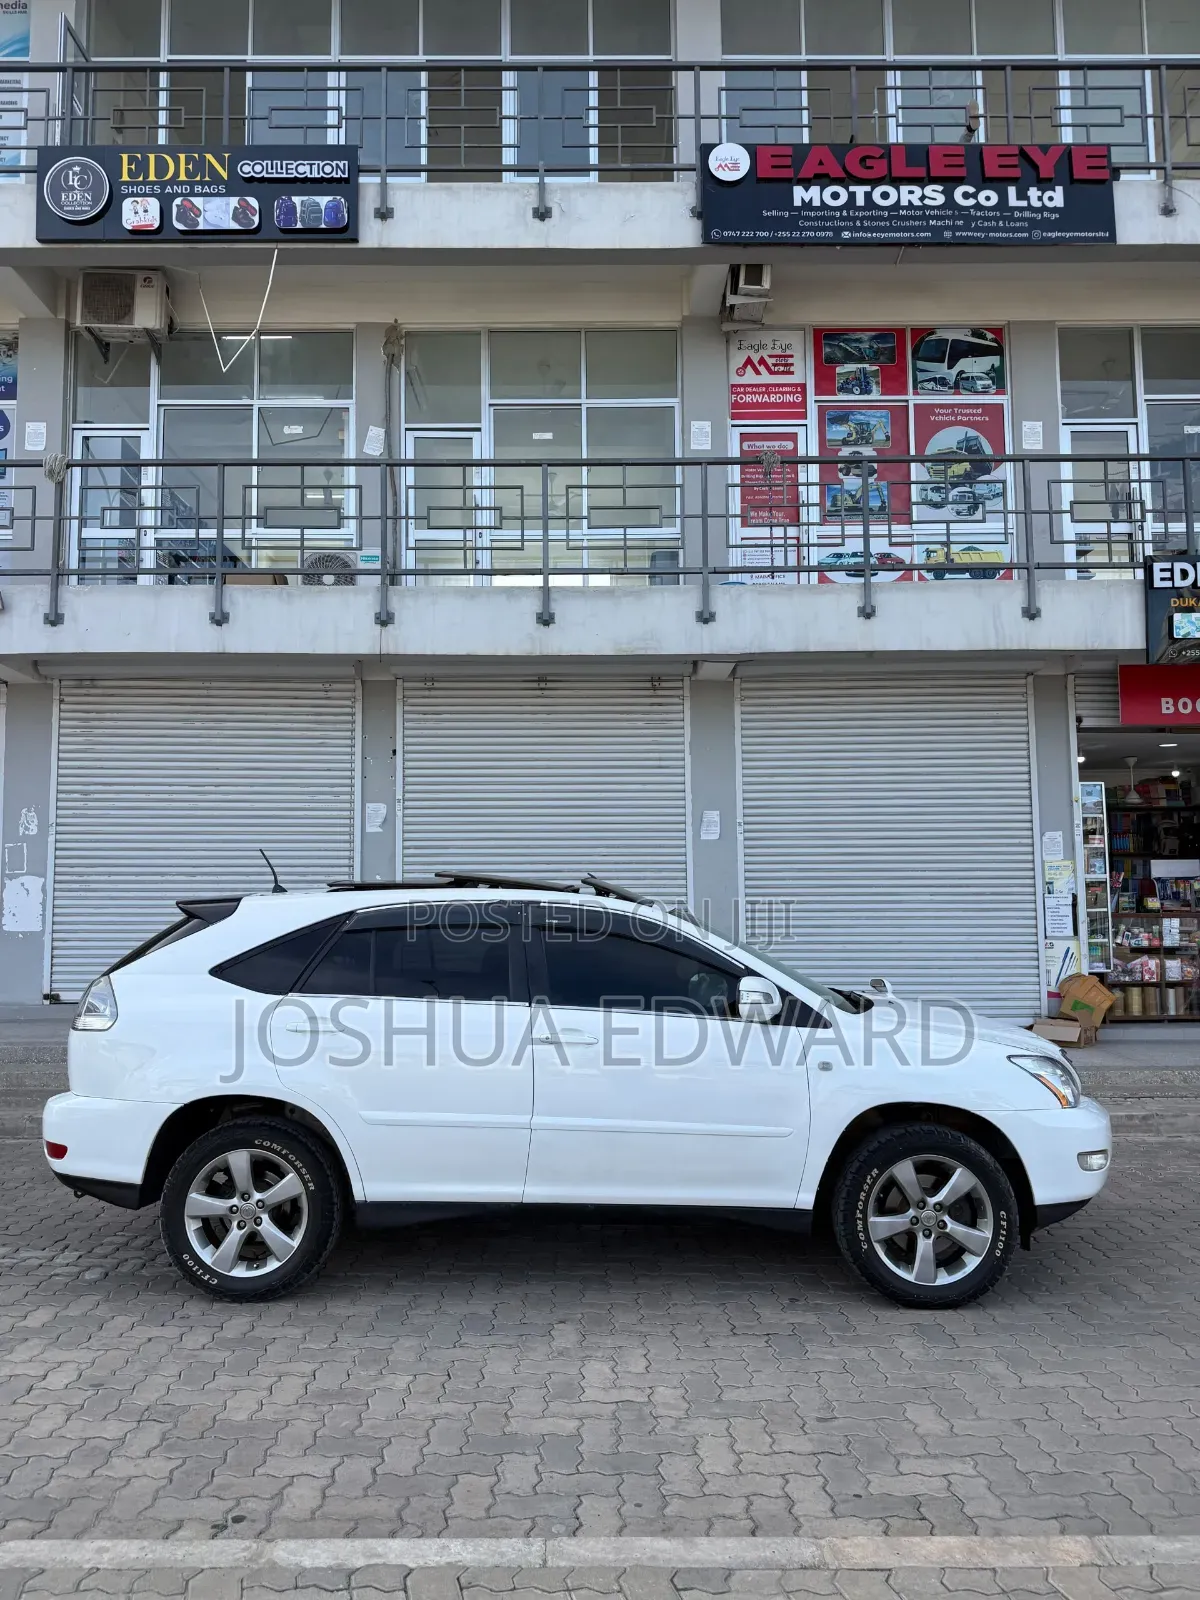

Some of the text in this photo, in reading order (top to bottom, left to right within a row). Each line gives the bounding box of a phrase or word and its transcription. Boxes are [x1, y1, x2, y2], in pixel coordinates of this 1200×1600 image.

[118, 153, 349, 182] EDEN COLLECTION
[756, 145, 1111, 180] EAGLE EYE
[61, 192, 92, 201] EDEN
[120, 185, 226, 194] SHOES AND BAGS
[793, 185, 1065, 208] MOTORS Co Ltd
[762, 209, 789, 218] Selling
[801, 209, 841, 218] Importing
[841, 209, 848, 217] &
[849, 209, 889, 218] Exporting
[1013, 210, 1042, 220] Drilling
[1043, 211, 1060, 220] Rigs
[798, 219, 854, 227] Constructions
[855, 219, 862, 227] &
[863, 219, 890, 227] Stones
[891, 219, 927, 227] Crushers
[977, 219, 997, 227] Cash
[1005, 220, 1029, 228] Loans
[737, 339, 793, 354] Eagle Eye
[731, 393, 803, 403] FORWARDING
[1152, 561, 1200, 588] ED
[1170, 597, 1200, 607] DUK
[254, 1138, 315, 1191] COMFORSER
[855, 1167, 879, 1250] COMFORSER
[182, 1253, 218, 1285] CF1100
